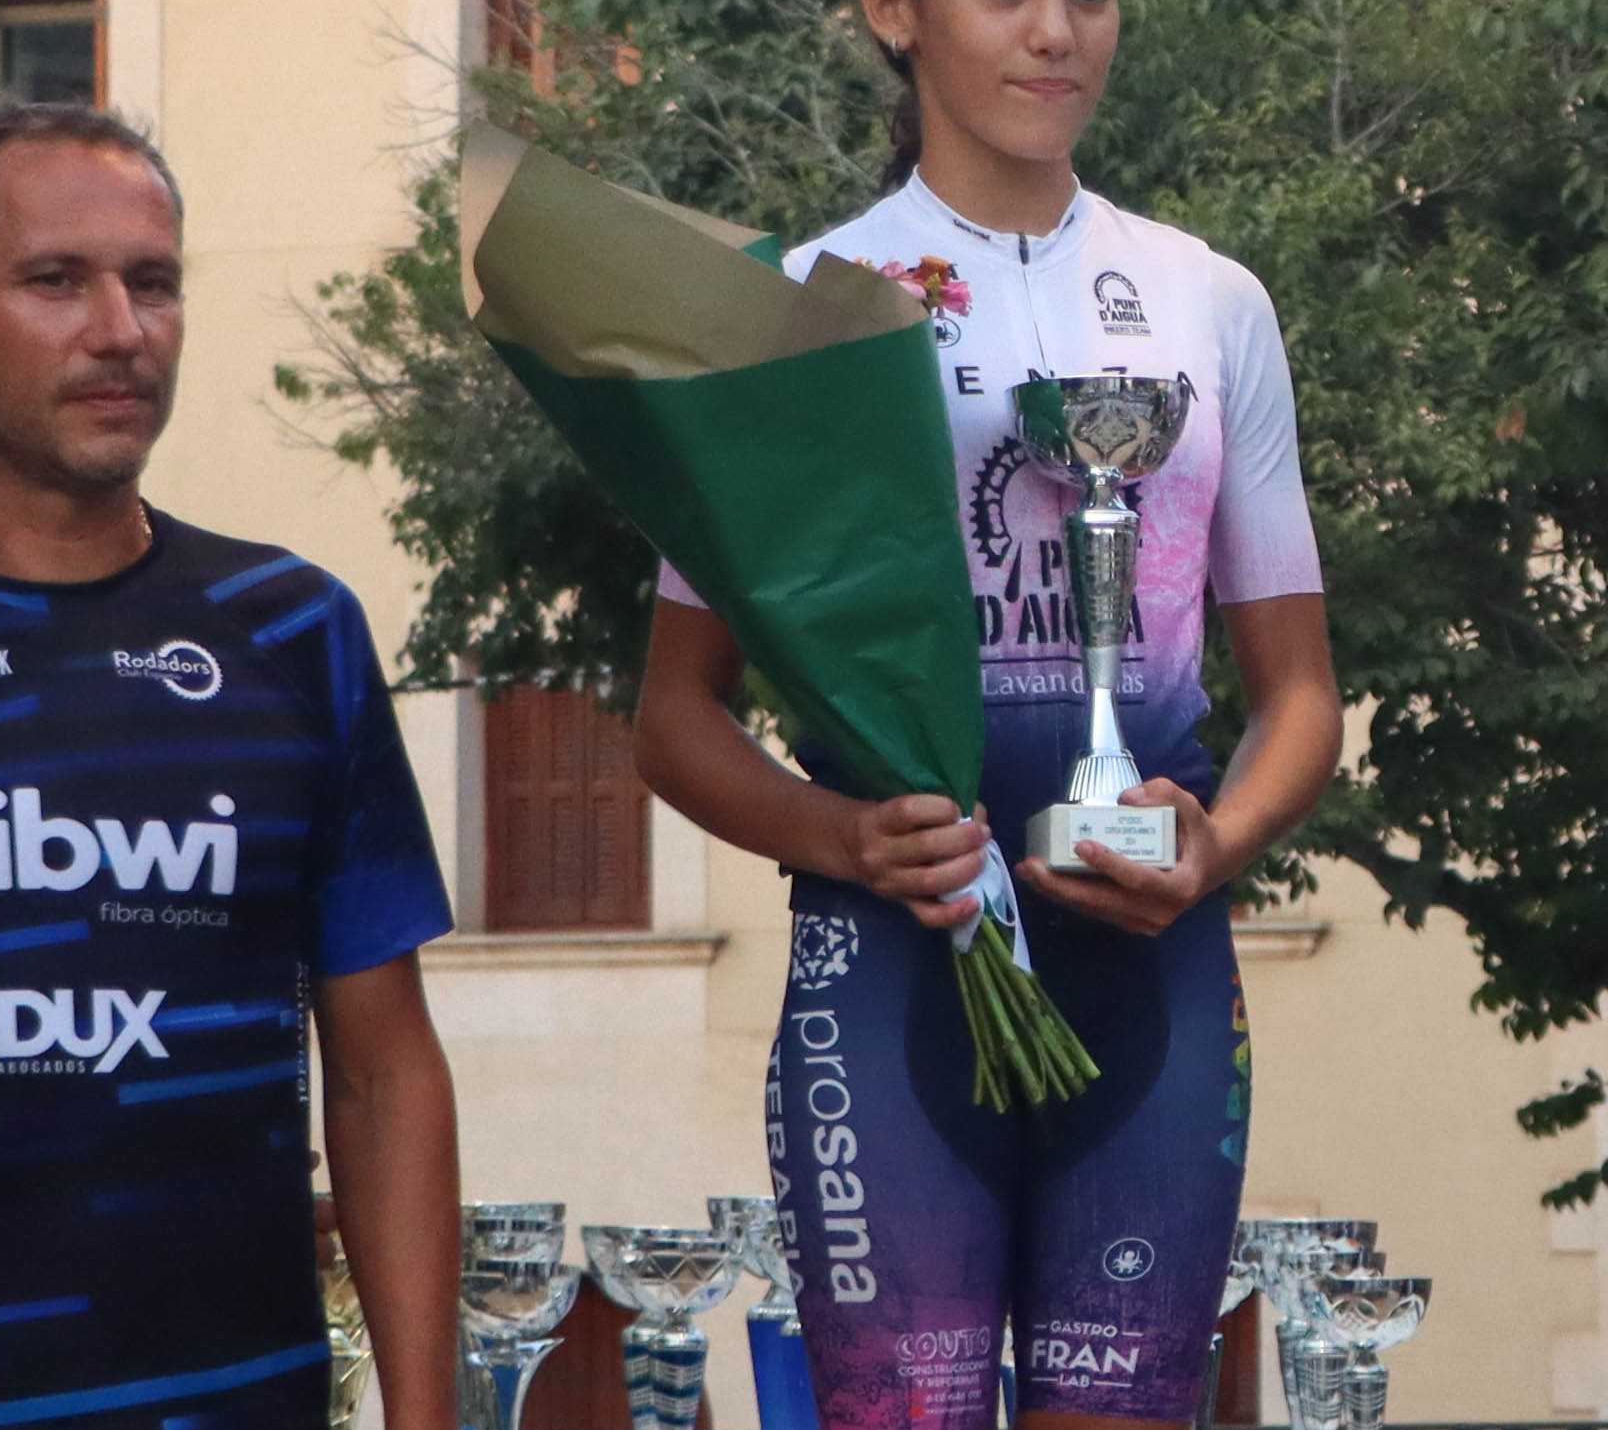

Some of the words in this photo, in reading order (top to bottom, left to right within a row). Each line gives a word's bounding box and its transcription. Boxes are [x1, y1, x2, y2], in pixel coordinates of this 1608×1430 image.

[1112, 298, 1143, 312] PUNT
[113, 650, 211, 676] Rodadors
[100, 901, 154, 923] fibra
[160, 904, 229, 930] óptica
[791, 1009, 878, 1304] prosana
[1050, 1320, 1118, 1339] GASTRO
[895, 1326, 991, 1362] COUTO
[1032, 1339, 1140, 1375] FRAN
[1058, 1374, 1090, 1388] LAB
